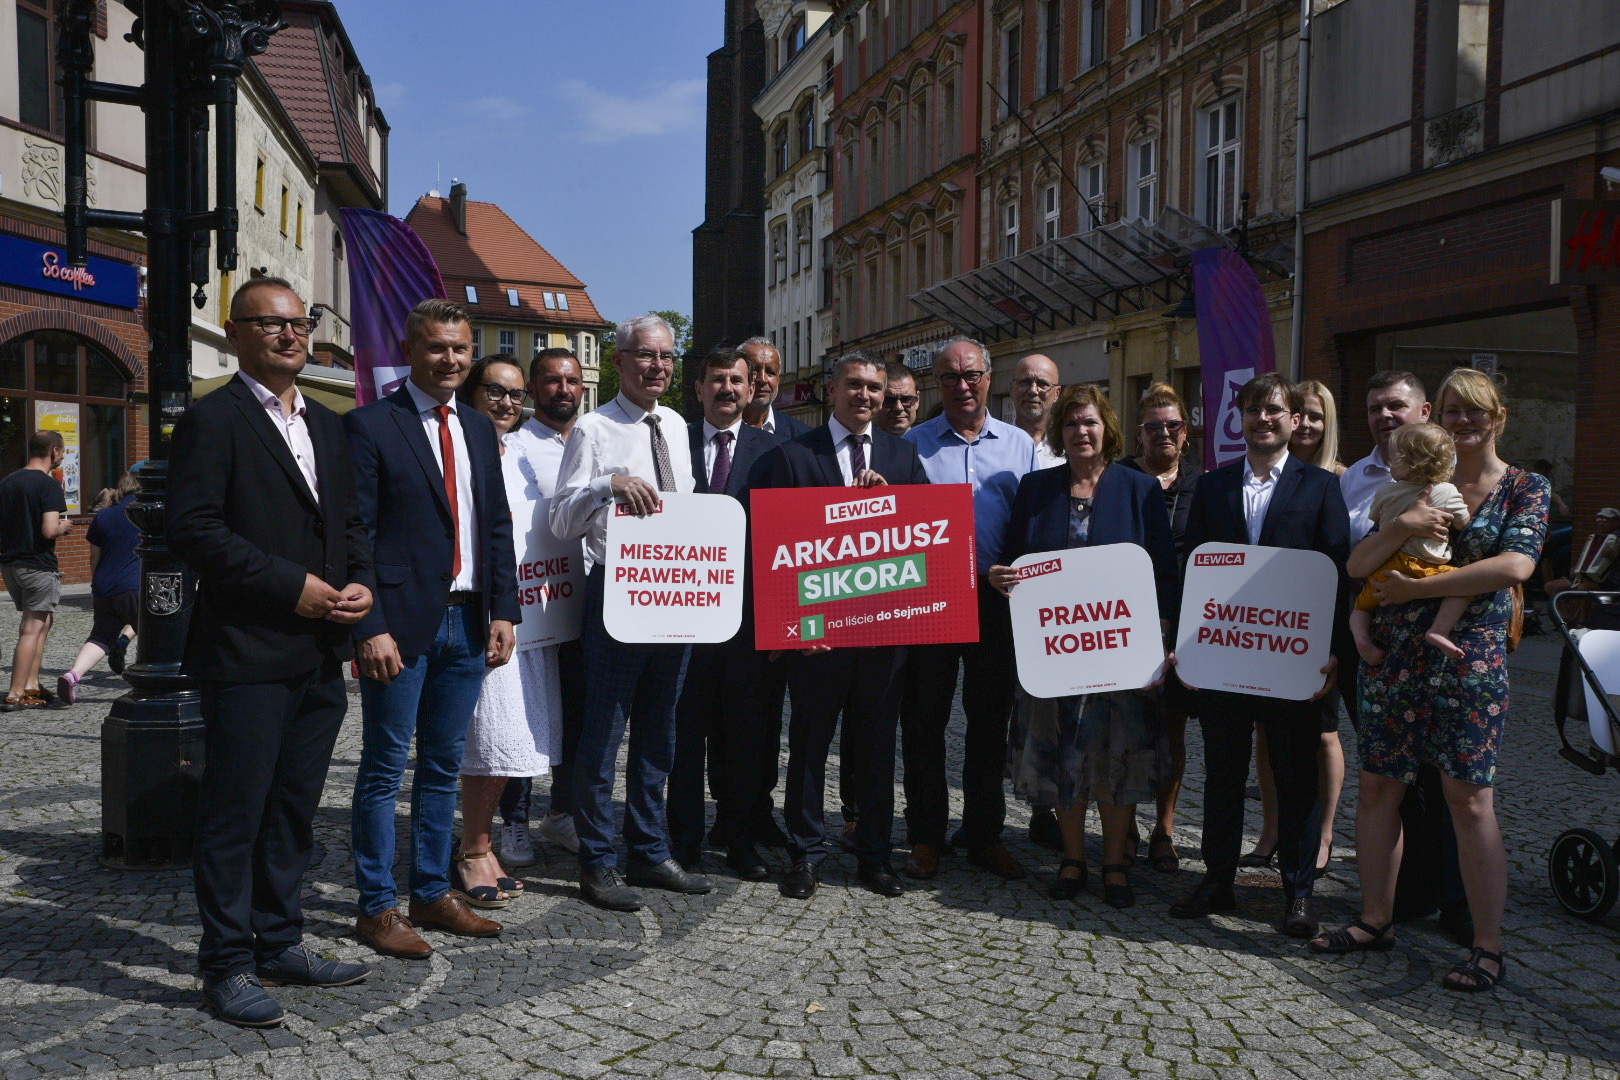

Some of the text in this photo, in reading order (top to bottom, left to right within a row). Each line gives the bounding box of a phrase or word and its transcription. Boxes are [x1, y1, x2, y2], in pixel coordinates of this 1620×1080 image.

[42, 252, 96, 290] So coffee
[829, 498, 892, 520] LEWICA
[620, 543, 727, 562] MIESZKANIE
[772, 519, 950, 570] ARKADIUSZ
[518, 556, 570, 581] IECKIE
[1198, 554, 1242, 565] LEWICA
[616, 566, 734, 586] PRAWEM, NIE
[803, 560, 921, 600] SIKORA
[628, 590, 721, 607] TOWAREM
[808, 601, 947, 636] 1 na liście do Sejmu RP
[1039, 599, 1132, 628] PRAWA
[1202, 598, 1310, 630] ŚWIECKIE
[1044, 628, 1131, 656] KOBIET
[1197, 626, 1309, 656] PAŃSTWO
